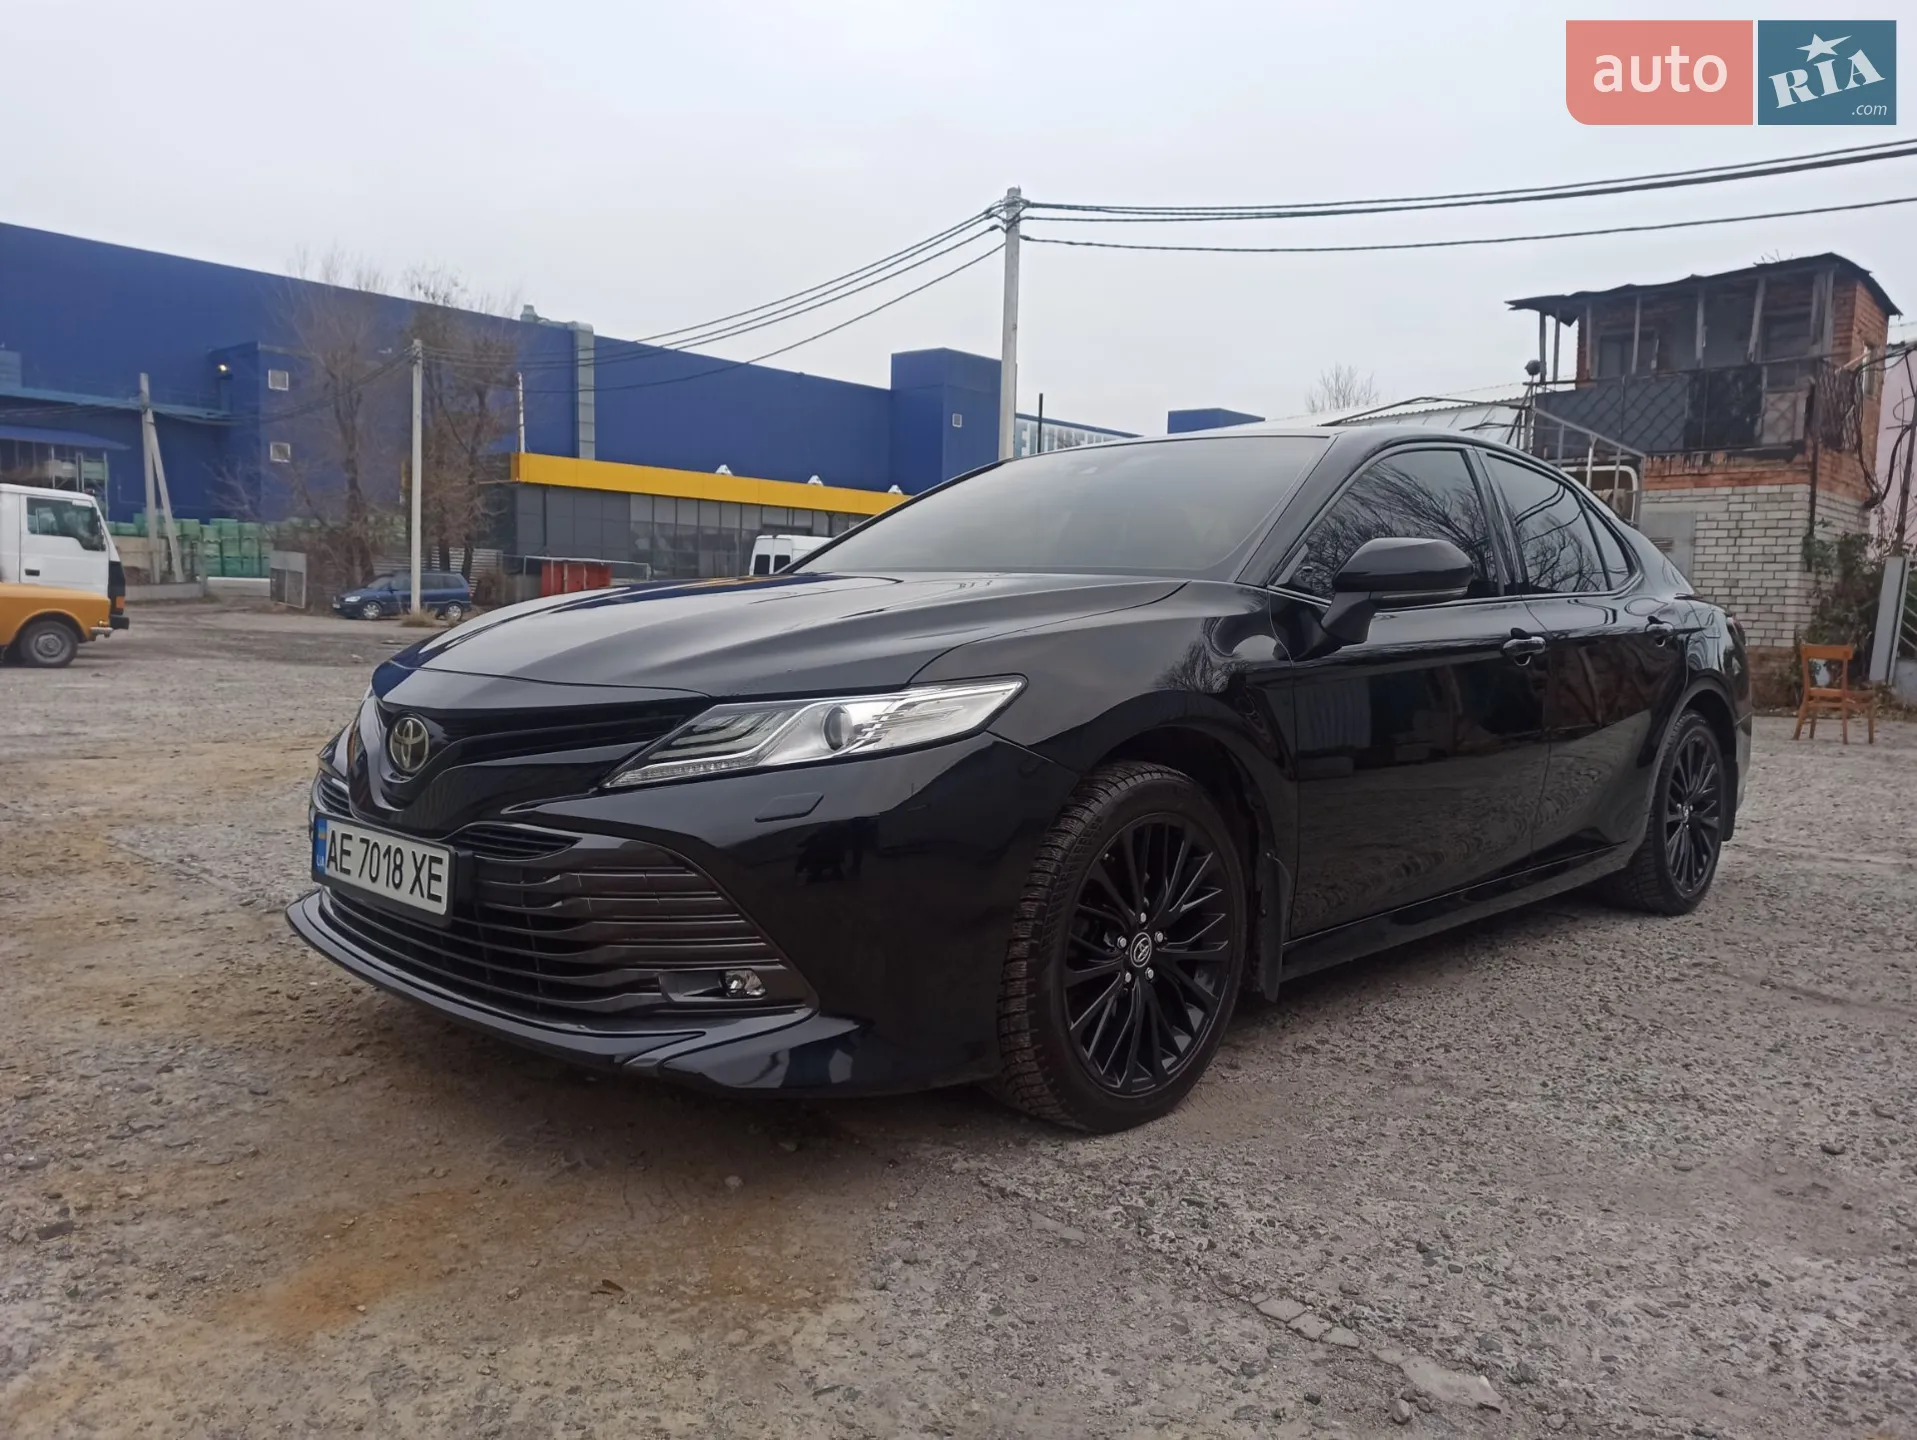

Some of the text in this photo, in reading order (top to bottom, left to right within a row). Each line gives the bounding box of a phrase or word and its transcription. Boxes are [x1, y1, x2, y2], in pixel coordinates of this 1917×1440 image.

[326, 829, 443, 903] AE 7018 XE
